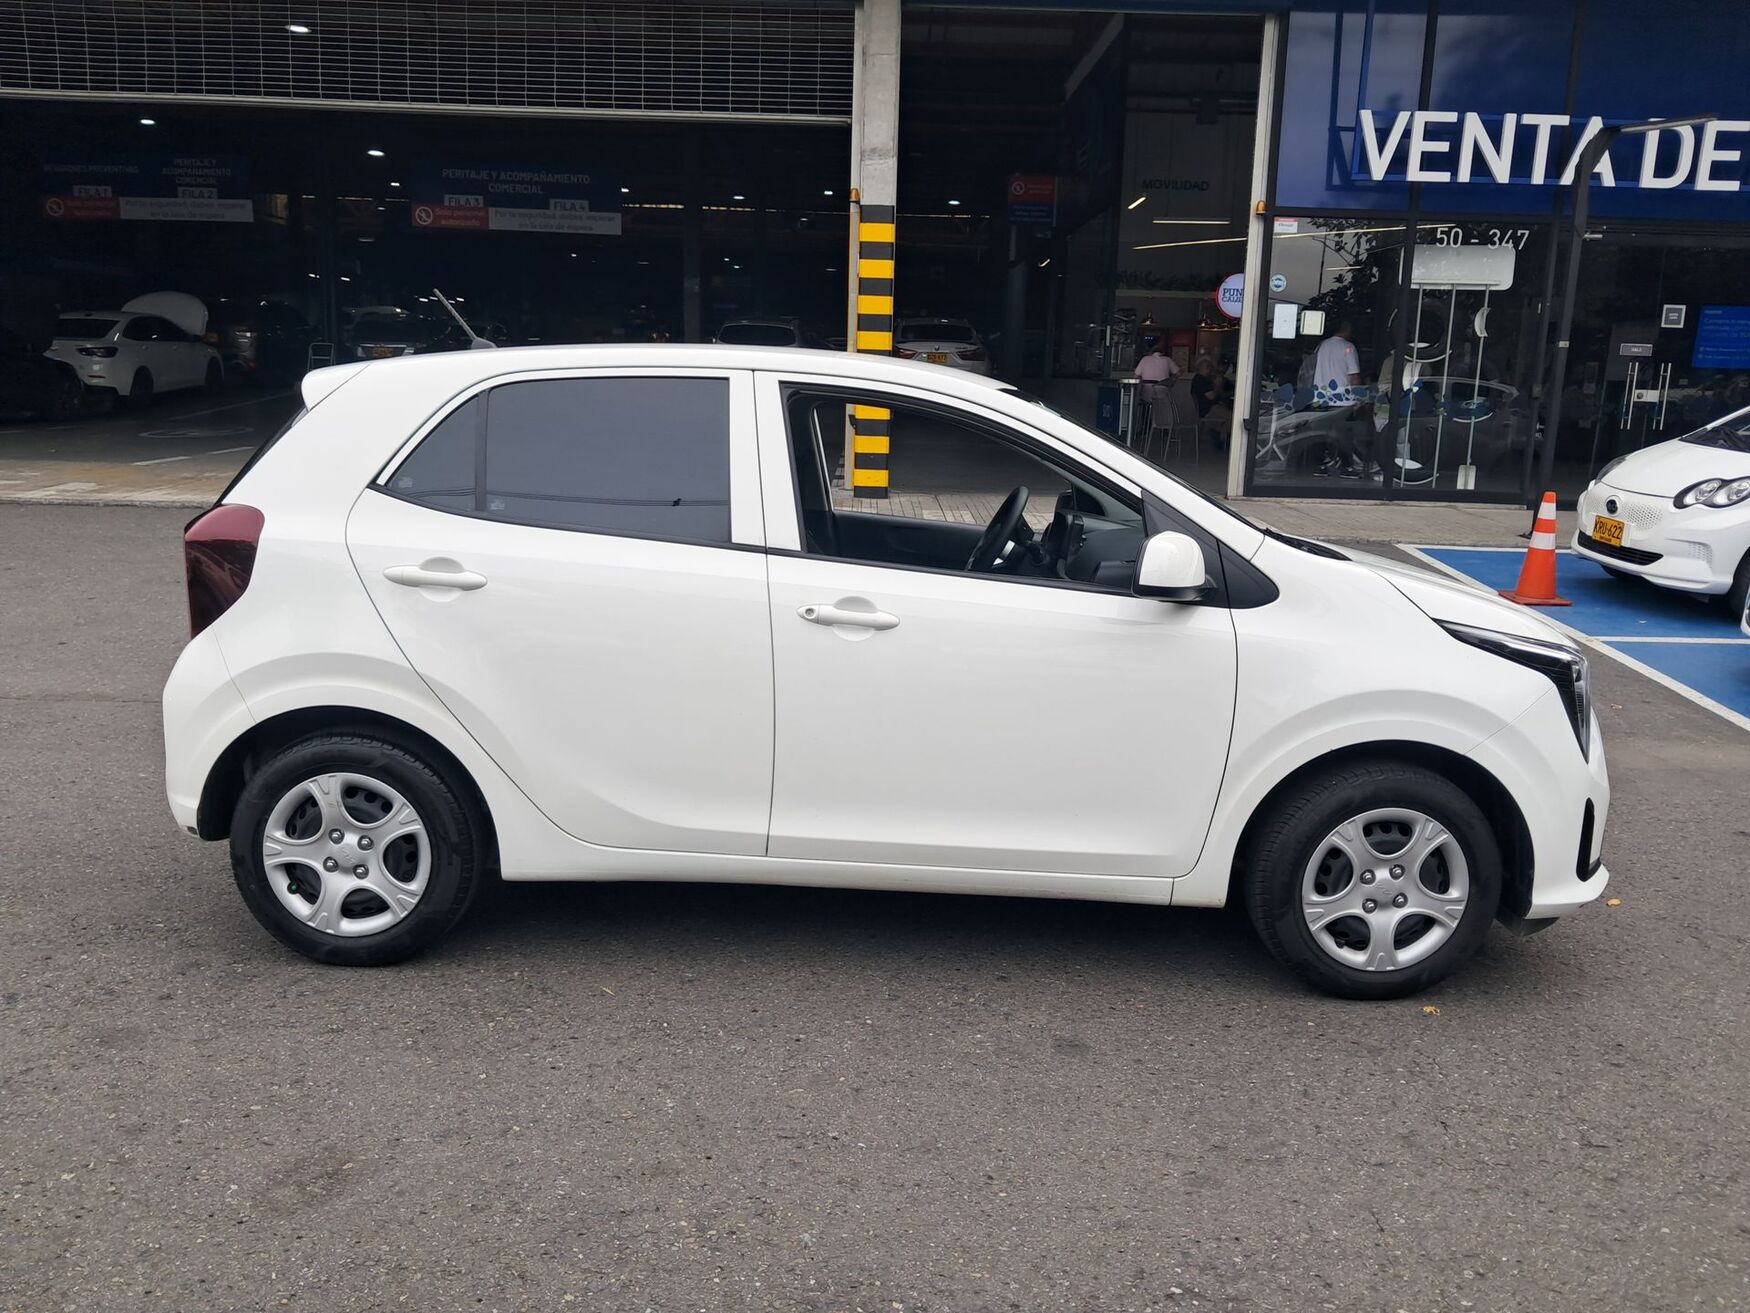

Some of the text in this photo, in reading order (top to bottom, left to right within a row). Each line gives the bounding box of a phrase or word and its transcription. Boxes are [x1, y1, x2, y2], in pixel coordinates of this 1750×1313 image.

[1359, 109, 1750, 192] VENTA DE
[442, 168, 591, 184] PERITAJE Y ACOMPAÑAMIENTO
[488, 182, 545, 194] COMERCIAL
[1142, 179, 1209, 191] MOVILIDAD
[448, 196, 471, 206] FILA
[554, 200, 577, 211] FILA
[1436, 227, 1463, 248] 50
[1487, 228, 1530, 250] 347
